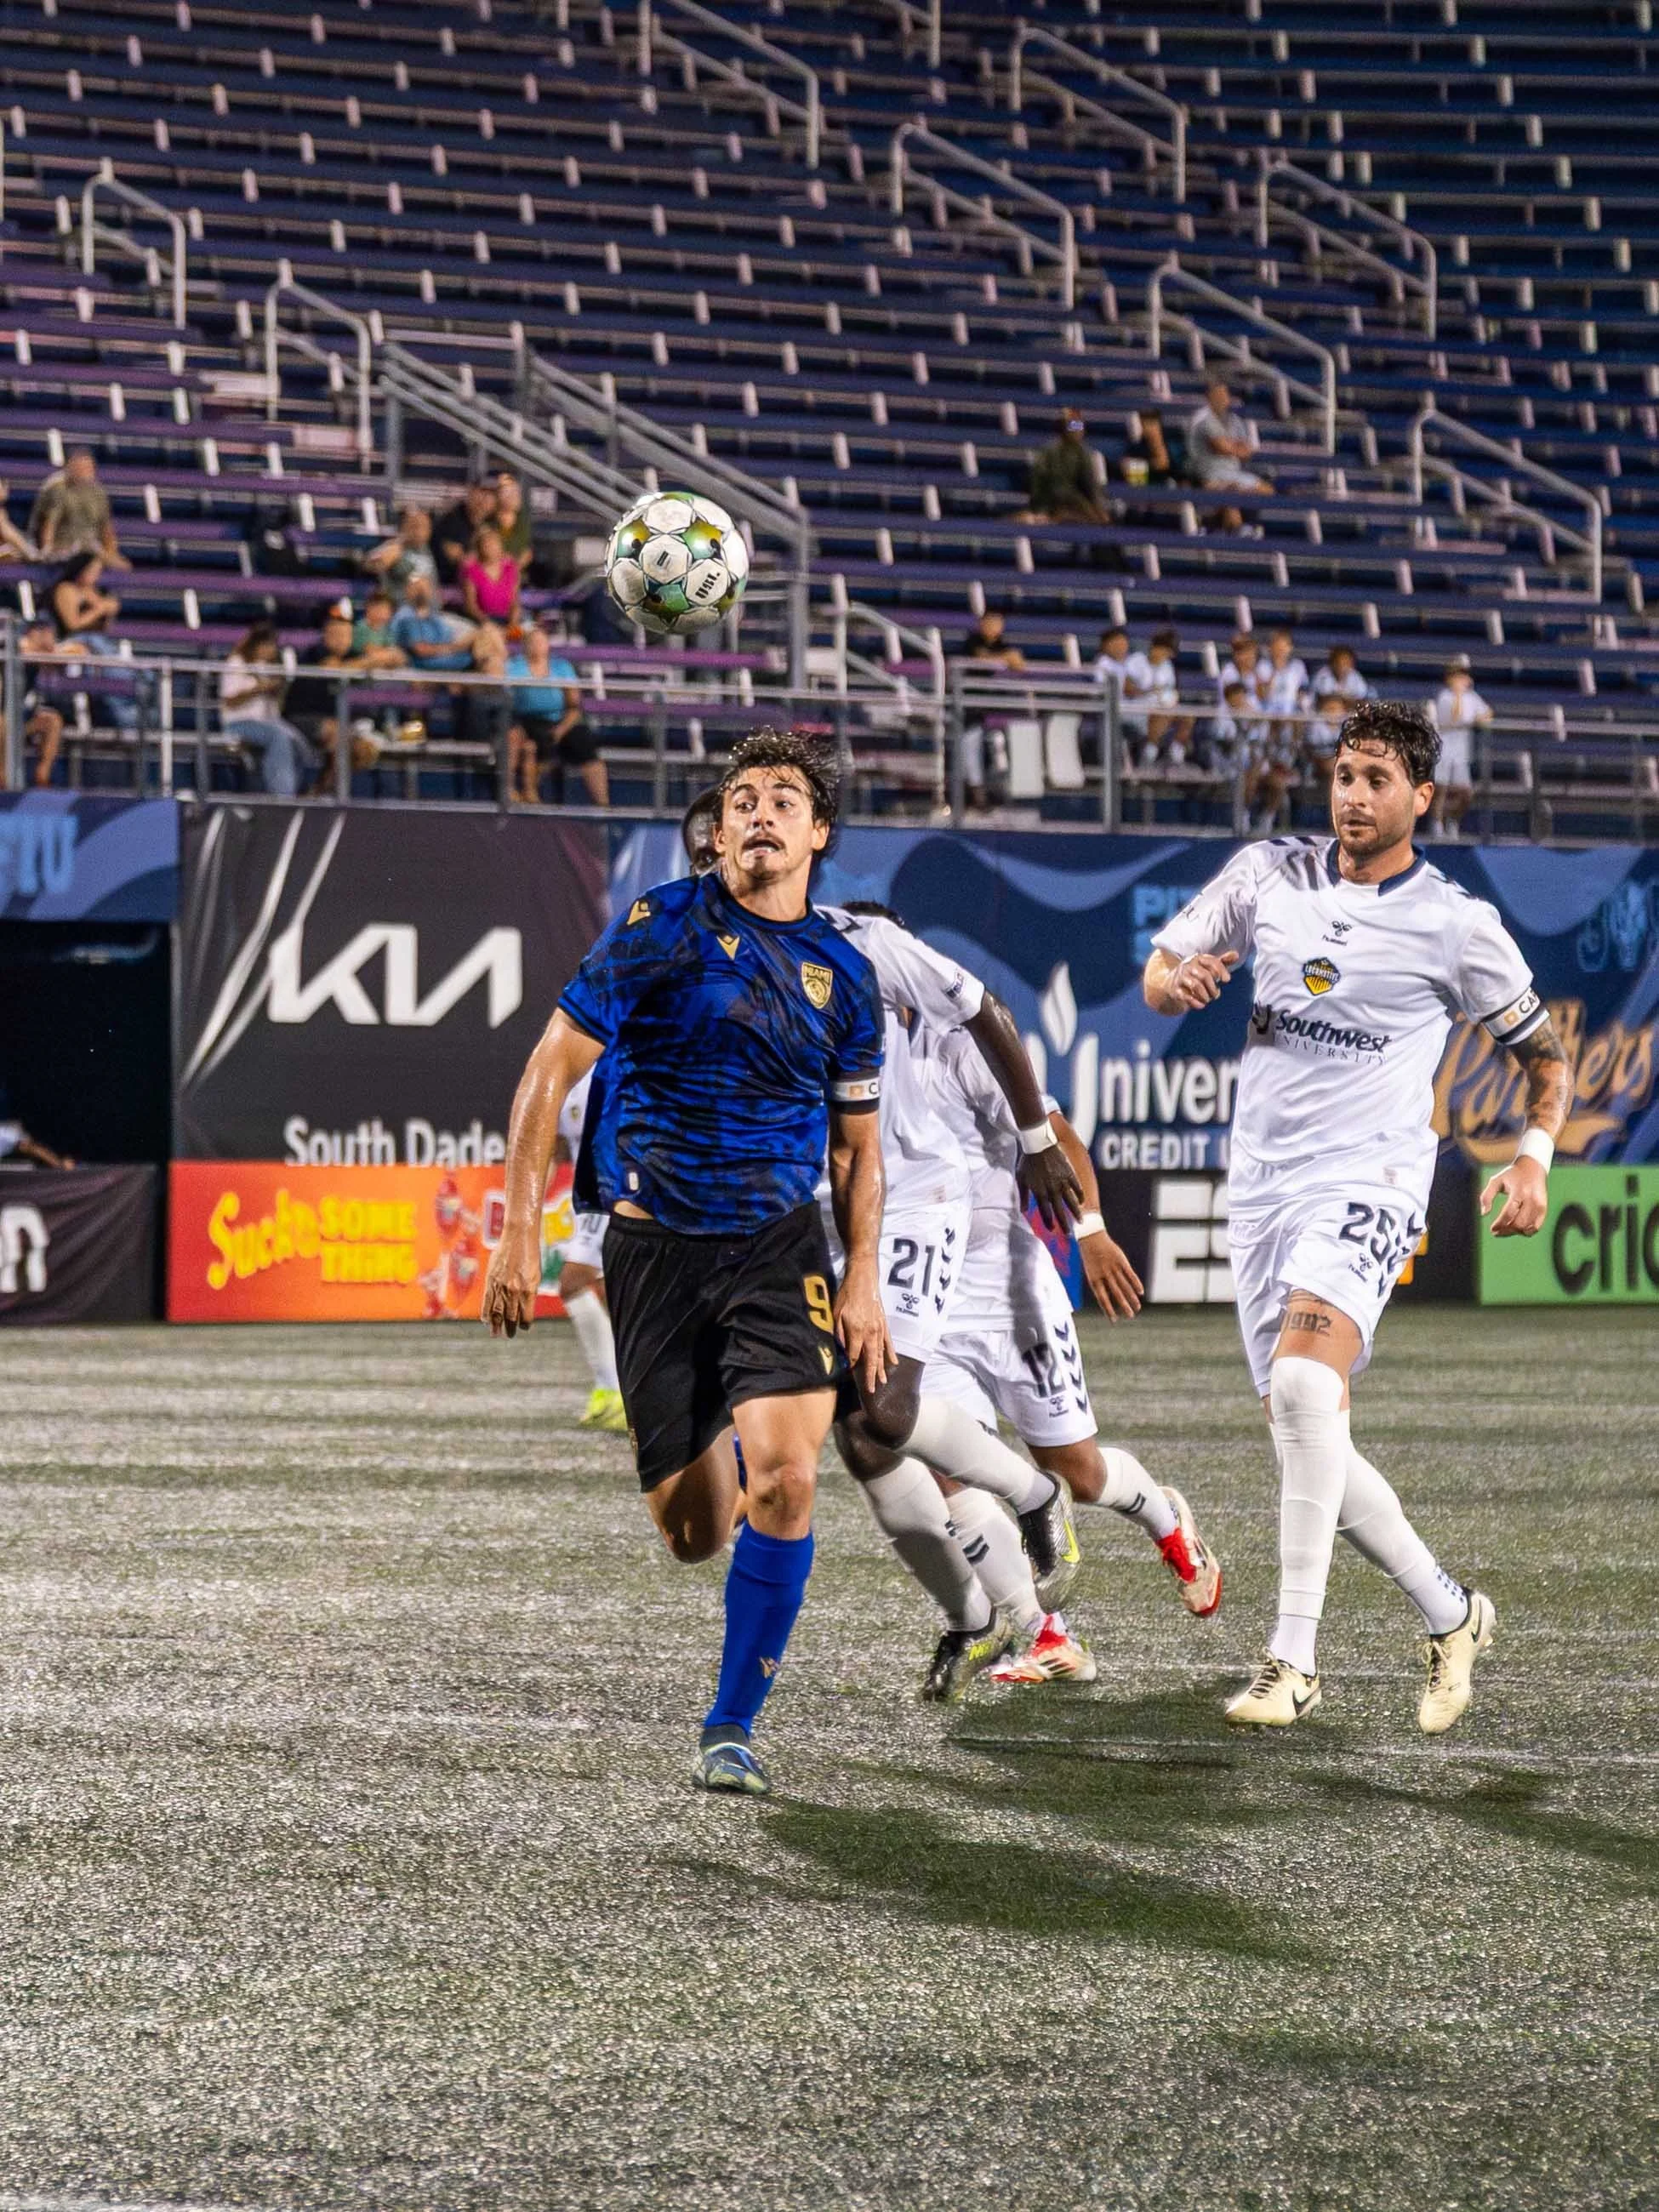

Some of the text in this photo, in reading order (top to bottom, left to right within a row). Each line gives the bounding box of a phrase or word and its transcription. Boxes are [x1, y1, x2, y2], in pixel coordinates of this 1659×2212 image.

[1275, 1009, 1392, 1052] Southwest
[284, 1114, 506, 1166] South Dade
[1100, 1132, 1211, 1169] CREDIT
[1338, 1201, 1397, 1265] 25
[887, 1238, 936, 1297] 21
[803, 1274, 834, 1335] 9
